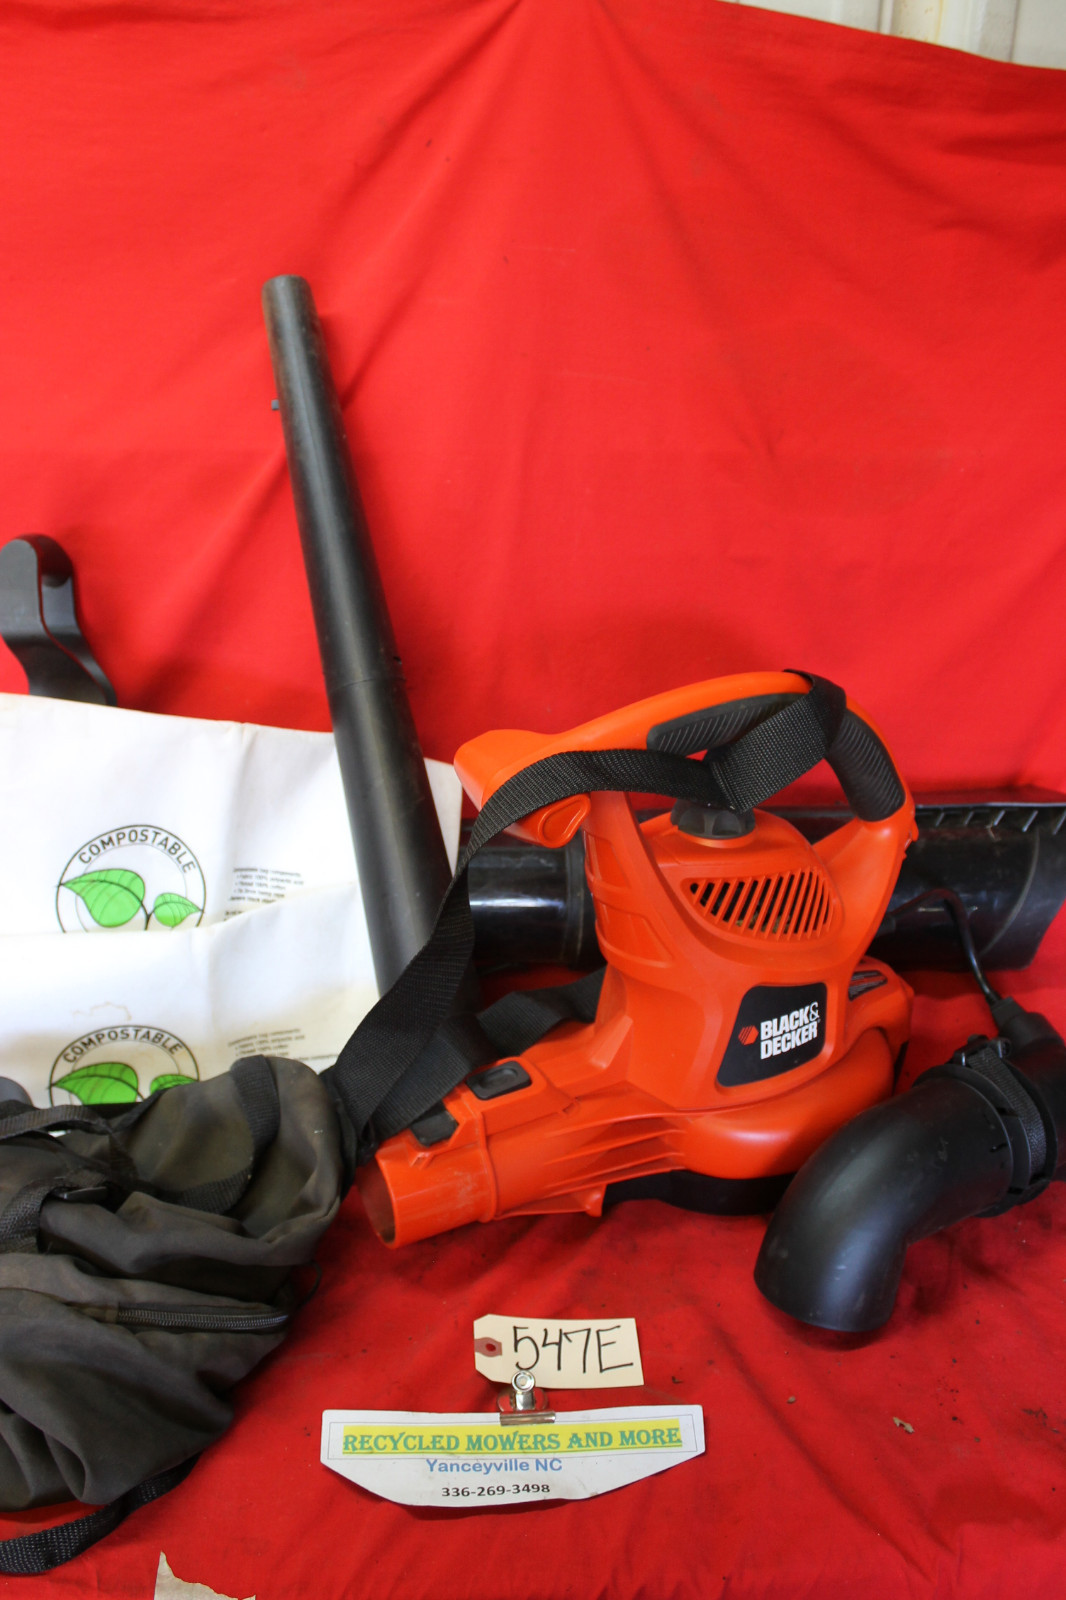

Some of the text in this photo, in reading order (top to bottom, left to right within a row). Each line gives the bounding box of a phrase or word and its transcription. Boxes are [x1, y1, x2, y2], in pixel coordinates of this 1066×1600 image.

[78, 829, 196, 873] COMPOSTABLE
[63, 1028, 184, 1063] COMPOSTABLE
[760, 1021, 818, 1060] DECKER
[513, 1325, 634, 1374] 547E
[343, 1427, 683, 1452] RECYCLED MOWERS AND MORE
[426, 1458, 563, 1475] Yanceyville NC
[441, 1484, 551, 1497] 336-269-3498
